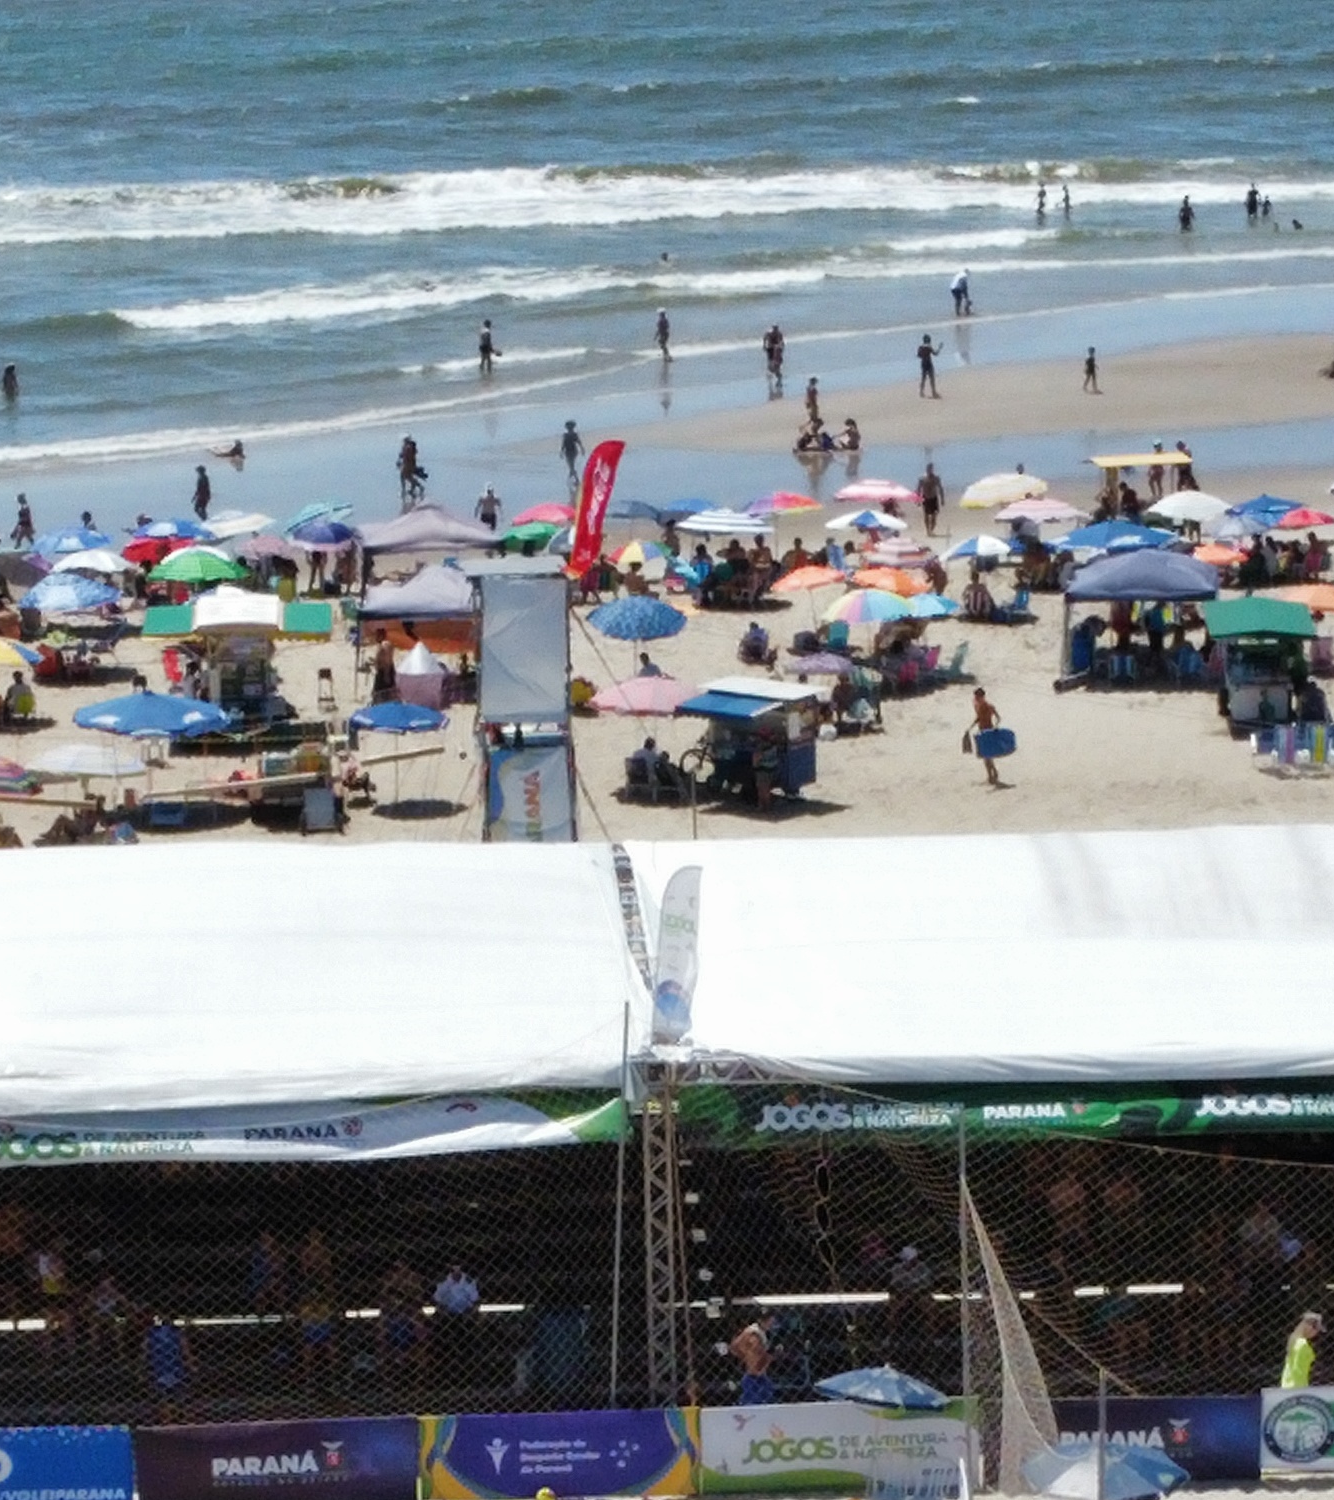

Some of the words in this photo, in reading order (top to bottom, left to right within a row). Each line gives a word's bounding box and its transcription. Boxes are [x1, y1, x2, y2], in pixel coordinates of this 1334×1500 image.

[755, 1104, 852, 1132] JOGOS
[1195, 1094, 1292, 1117] JOGOS
[742, 1435, 839, 1465] JOGOS
[839, 1434, 856, 1446] DE
[863, 1431, 948, 1446] AVENTURA
[211, 1450, 320, 1477] PARANÁ
